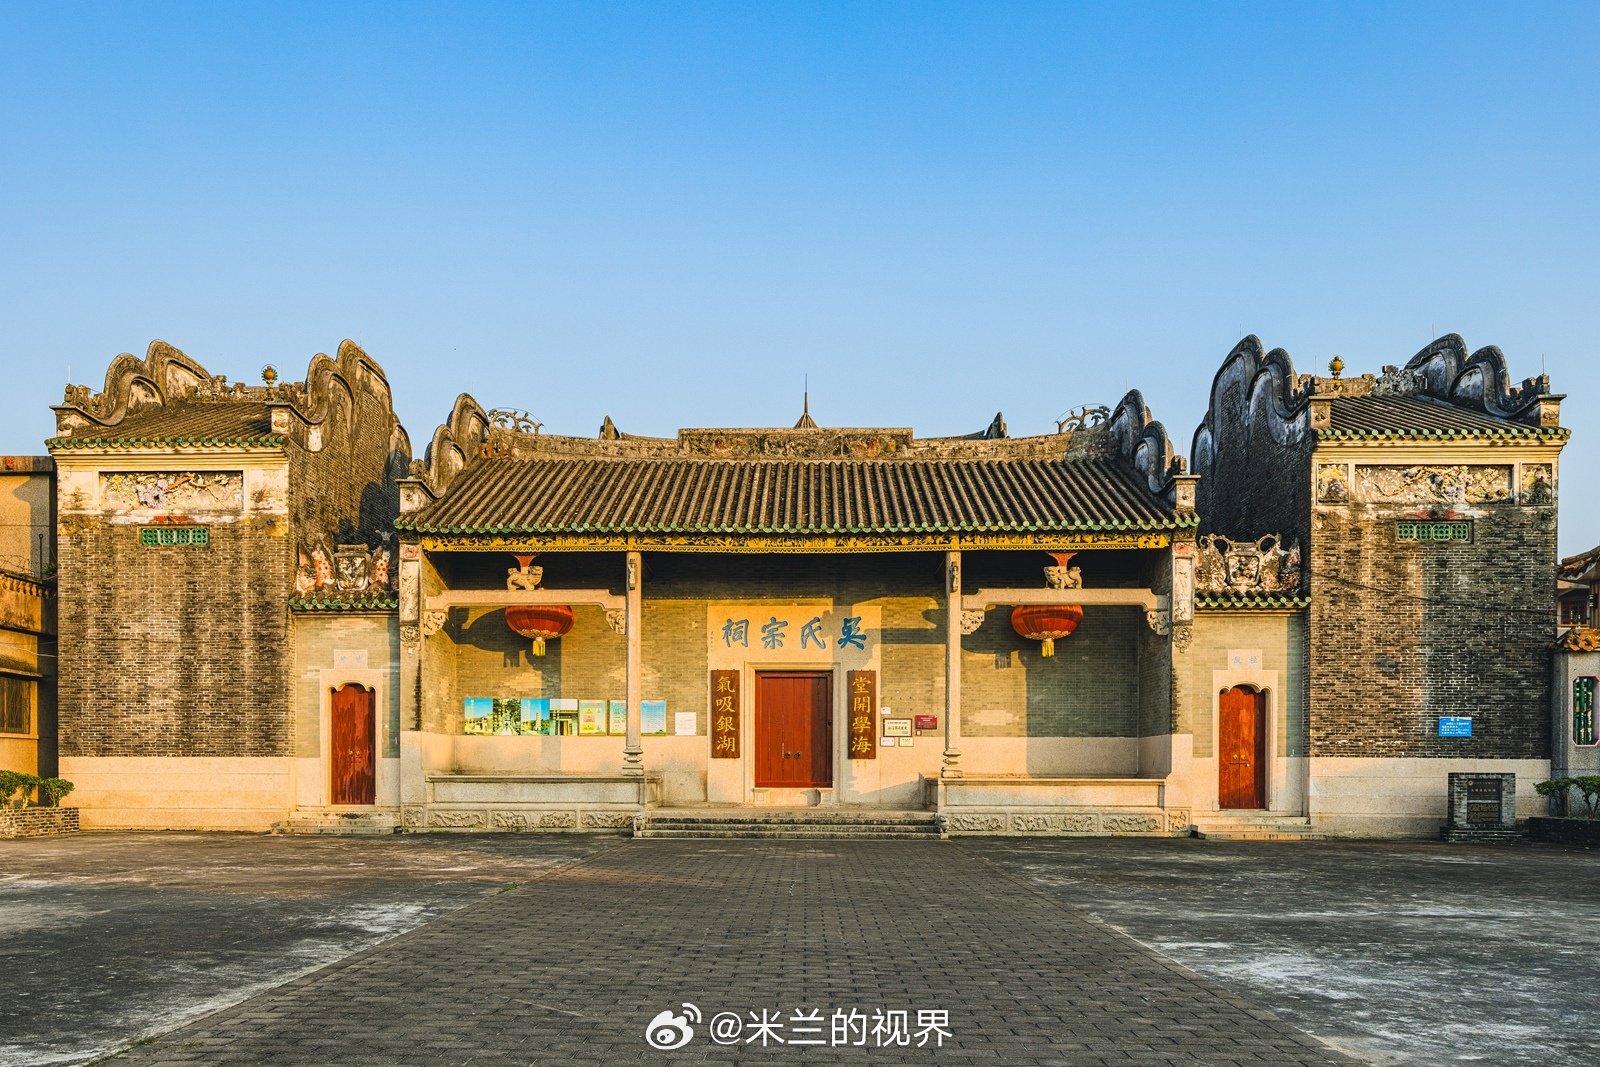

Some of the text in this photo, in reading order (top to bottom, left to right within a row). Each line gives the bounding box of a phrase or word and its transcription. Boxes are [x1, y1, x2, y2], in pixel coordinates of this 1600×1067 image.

[716, 675, 736, 753] 氣吸銀湖
[851, 676, 873, 753] 堂開學海
